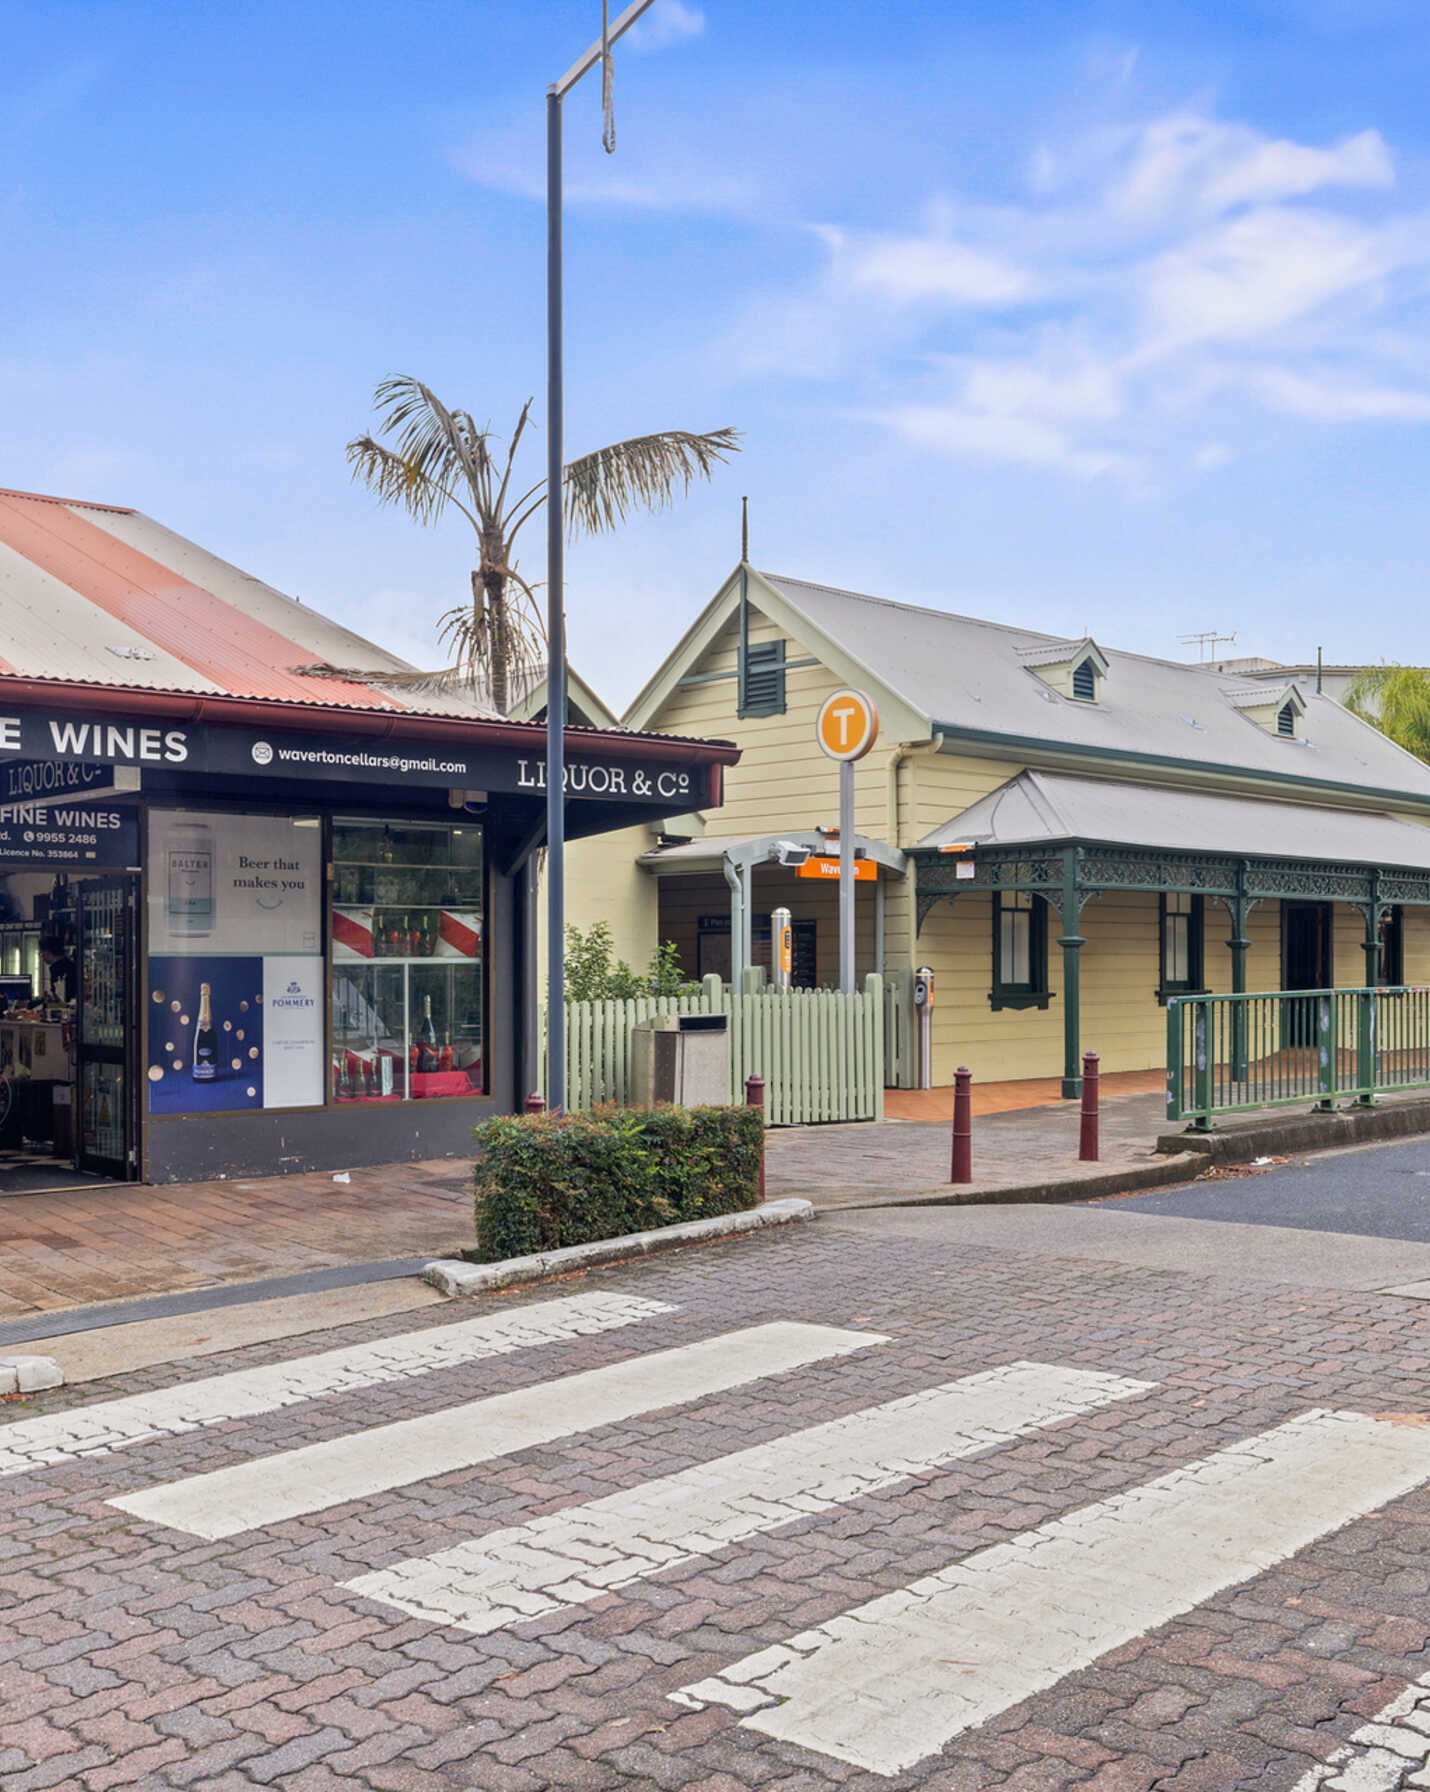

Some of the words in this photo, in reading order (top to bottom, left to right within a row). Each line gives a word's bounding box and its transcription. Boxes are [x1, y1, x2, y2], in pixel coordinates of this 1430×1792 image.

[833, 707, 856, 746] T
[48, 720, 189, 763] WINES
[278, 748, 467, 775] wavertoncellars@gmail.com
[9, 760, 66, 796] LIQUOR
[67, 760, 80, 786] &
[632, 770, 653, 796] &
[0, 807, 48, 825] FINE
[55, 811, 121, 829] WINES
[36, 831, 66, 844] 9955
[68, 834, 97, 845] 2486
[0, 848, 30, 857] Licence
[239, 856, 270, 869] Beer
[273, 858, 301, 871] that
[233, 876, 279, 889] makes
[281, 882, 305, 892] you
